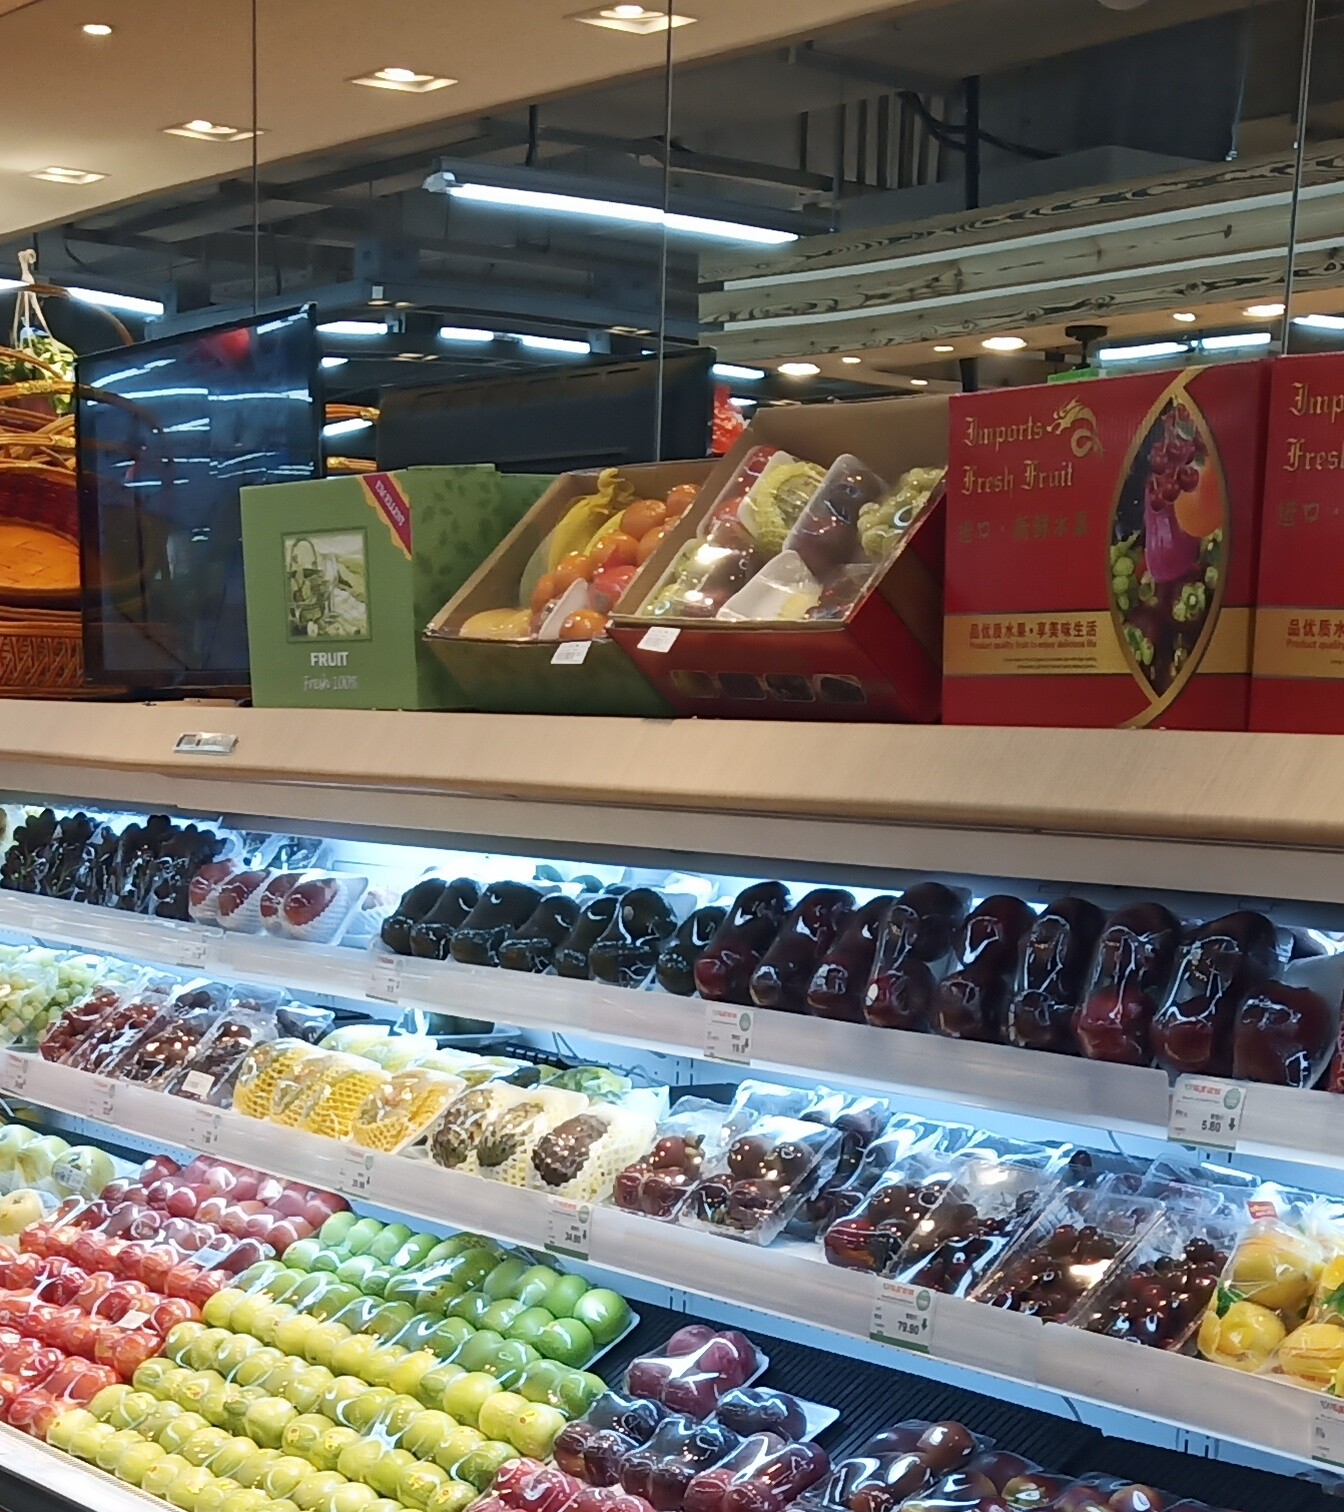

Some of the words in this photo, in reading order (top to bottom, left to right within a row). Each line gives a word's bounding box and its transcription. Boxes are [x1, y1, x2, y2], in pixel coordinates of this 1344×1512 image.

[963, 415, 1044, 453] Imports
[961, 465, 1014, 499] Fresh
[1020, 459, 1073, 490] Fruit
[310, 651, 349, 667] FRUIT
